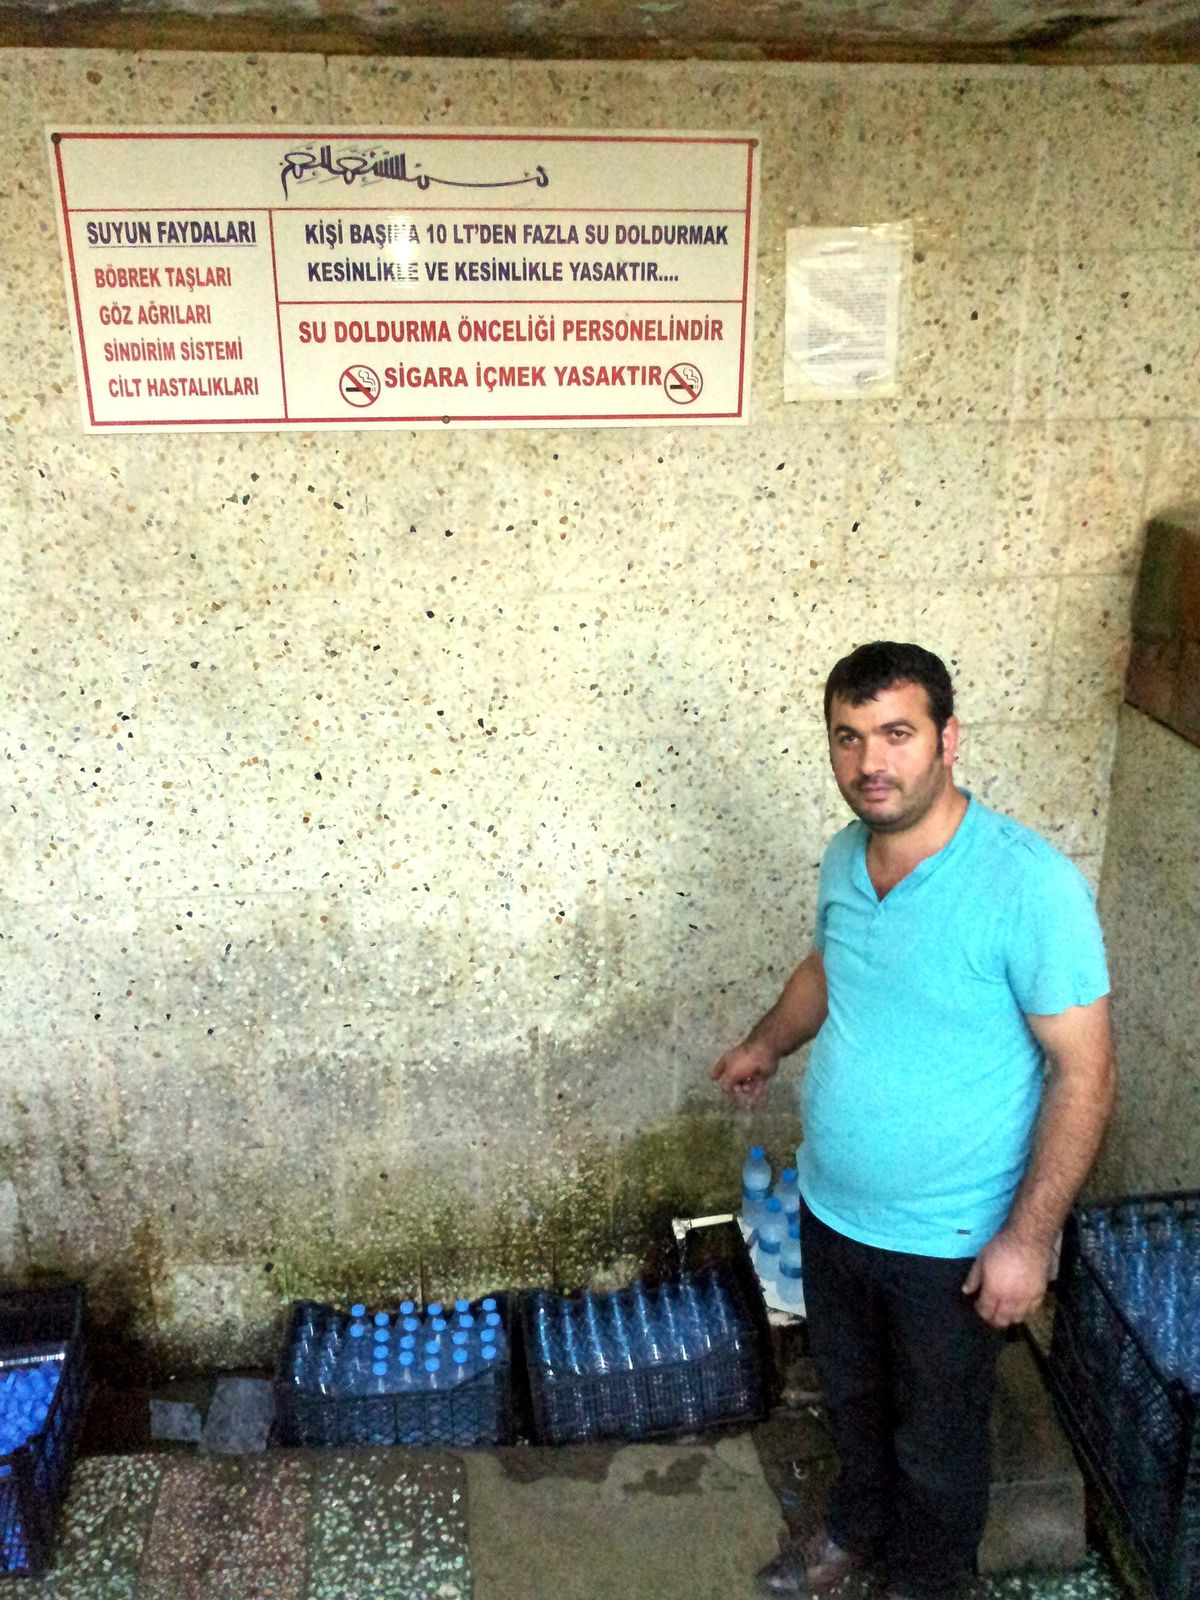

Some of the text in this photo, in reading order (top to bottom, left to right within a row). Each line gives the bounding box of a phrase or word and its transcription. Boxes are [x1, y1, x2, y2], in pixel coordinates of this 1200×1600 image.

[87, 221, 256, 246] SUYUN FAYDALARI
[305, 219, 343, 250] KİŞİ
[427, 224, 447, 244] 10
[523, 225, 579, 245] FAZLA
[585, 225, 610, 245] SU
[615, 225, 729, 246] DOLDURMAK
[95, 264, 232, 292] BÖBREK TAŞLARI
[307, 257, 419, 282] KESİNLİKLE
[425, 262, 449, 282] VE
[455, 257, 564, 282] KESİNLİKLE
[100, 301, 212, 326] GÖZ AĞRILARI
[299, 314, 724, 344] SU DOLDURMA ÖNCELİĞİ PERSONELİNDİR
[104, 335, 244, 362] SİNDİRİM SİSTEMİ
[108, 375, 259, 398] CİLT HASTALIKLARI
[384, 362, 663, 393] SİGARA İÇMEK YASAKTIR
